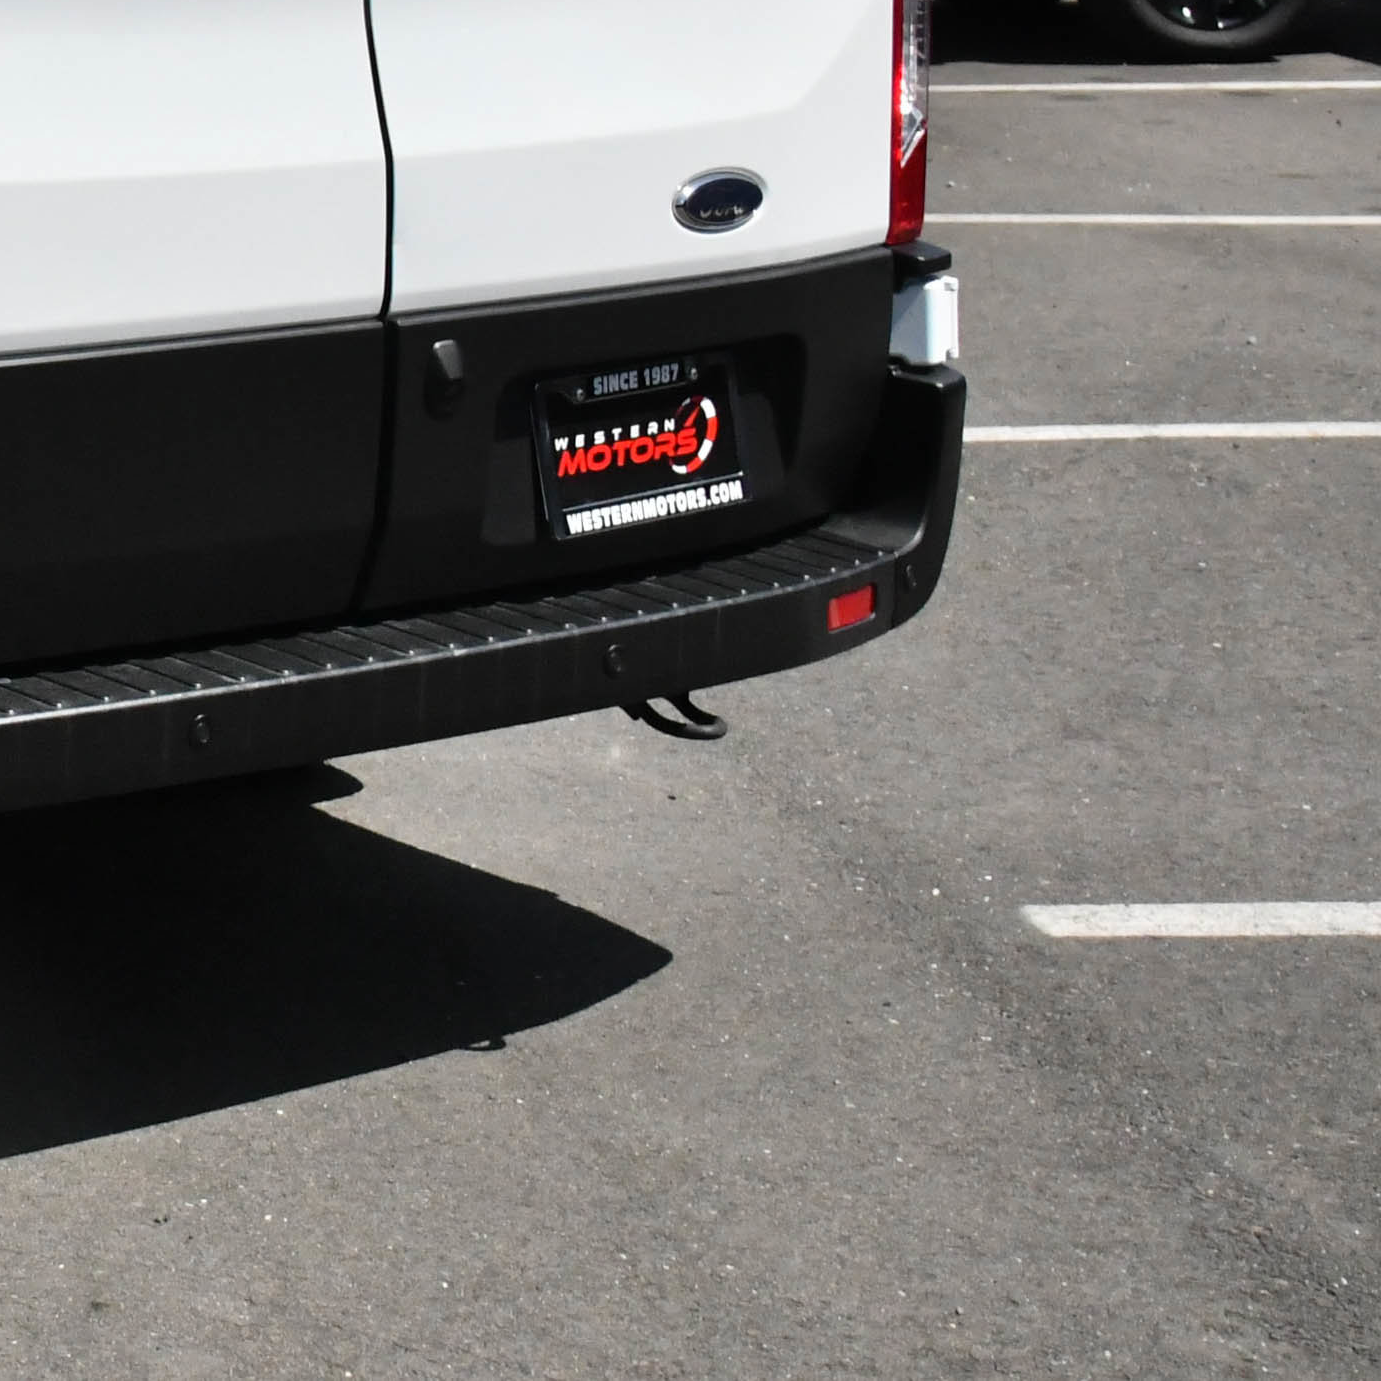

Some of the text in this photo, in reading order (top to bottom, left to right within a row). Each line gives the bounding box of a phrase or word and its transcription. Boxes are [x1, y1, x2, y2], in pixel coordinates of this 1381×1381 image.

[593, 363, 679, 396] SINCE 1987
[554, 418, 675, 451] WESTERN
[556, 427, 698, 478] MOTORS
[566, 480, 743, 535] WESTERNMOTORS.COM
